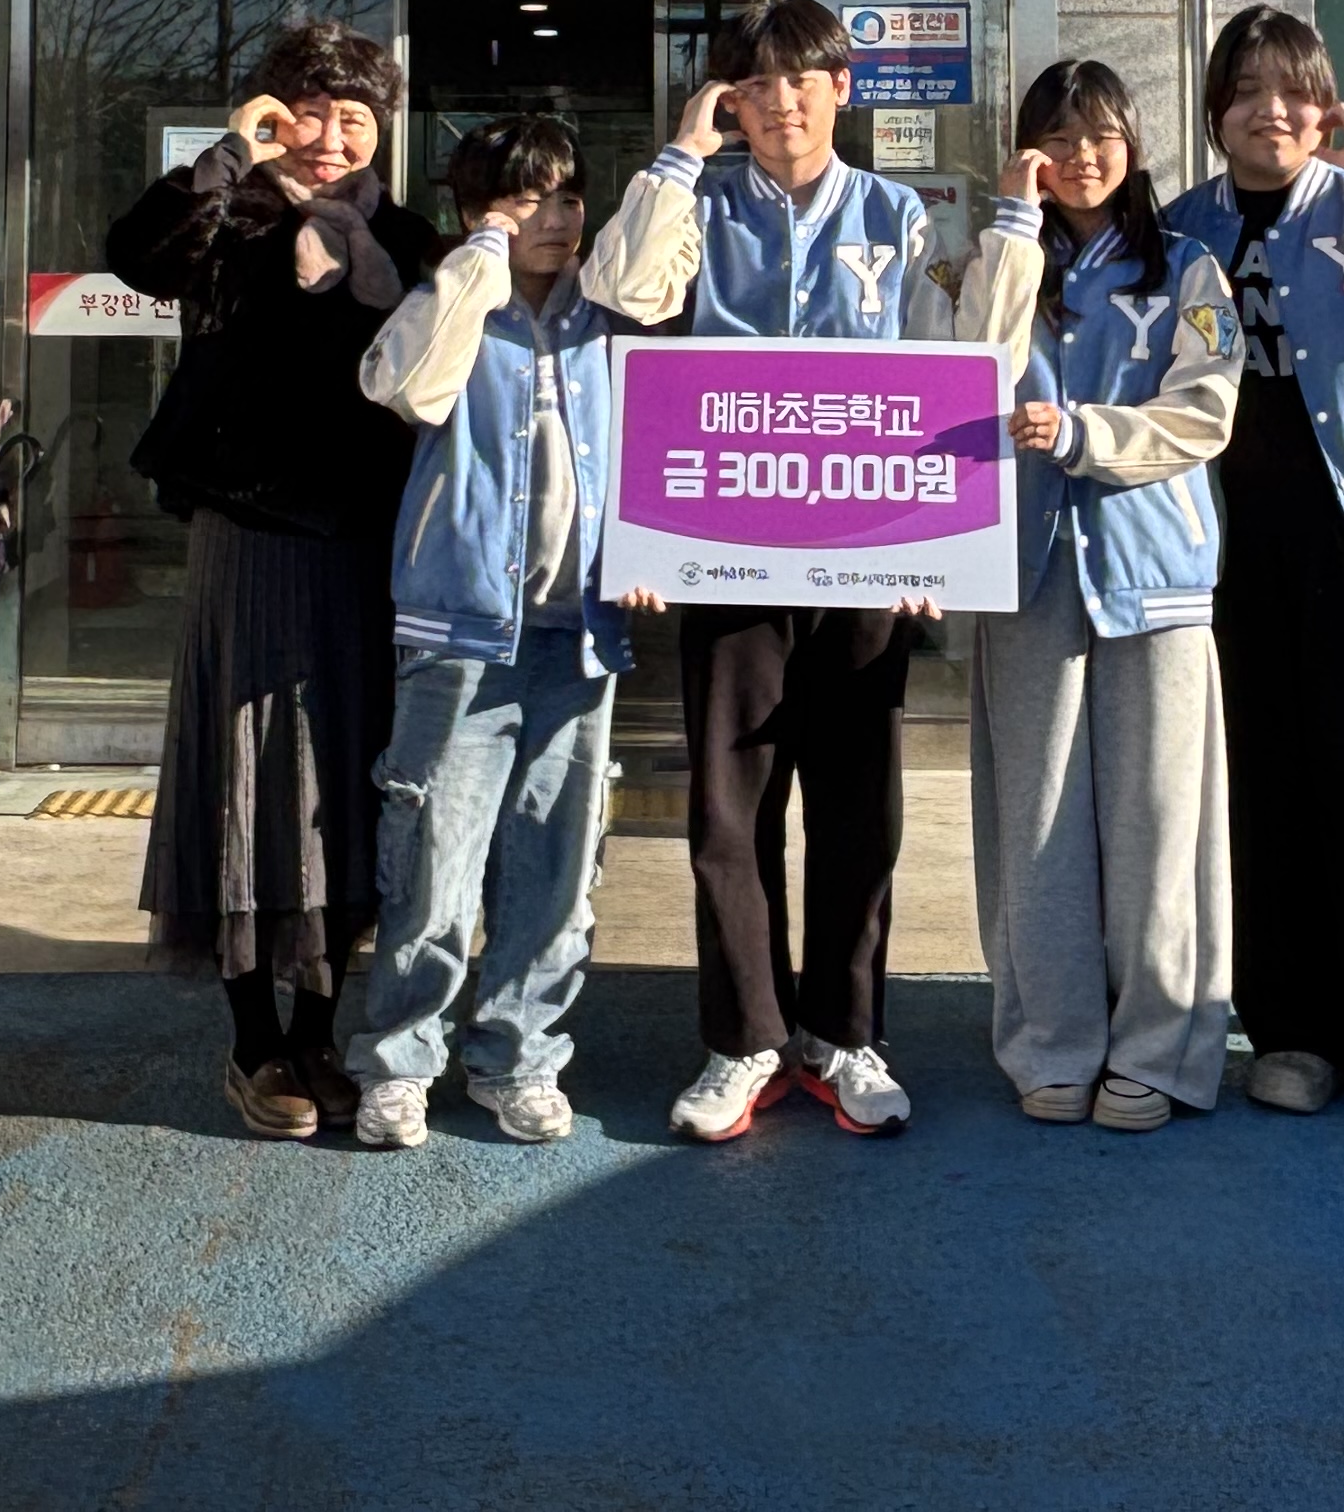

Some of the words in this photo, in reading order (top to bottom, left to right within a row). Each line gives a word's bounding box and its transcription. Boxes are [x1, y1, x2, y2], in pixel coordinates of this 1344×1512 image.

[79, 293, 141, 317] 부강한
[836, 245, 897, 313] Y
[1109, 293, 1171, 360] Y
[700, 391, 925, 437] 예하초등학교
[663, 449, 708, 499] 금
[717, 451, 958, 505] 300,000원
